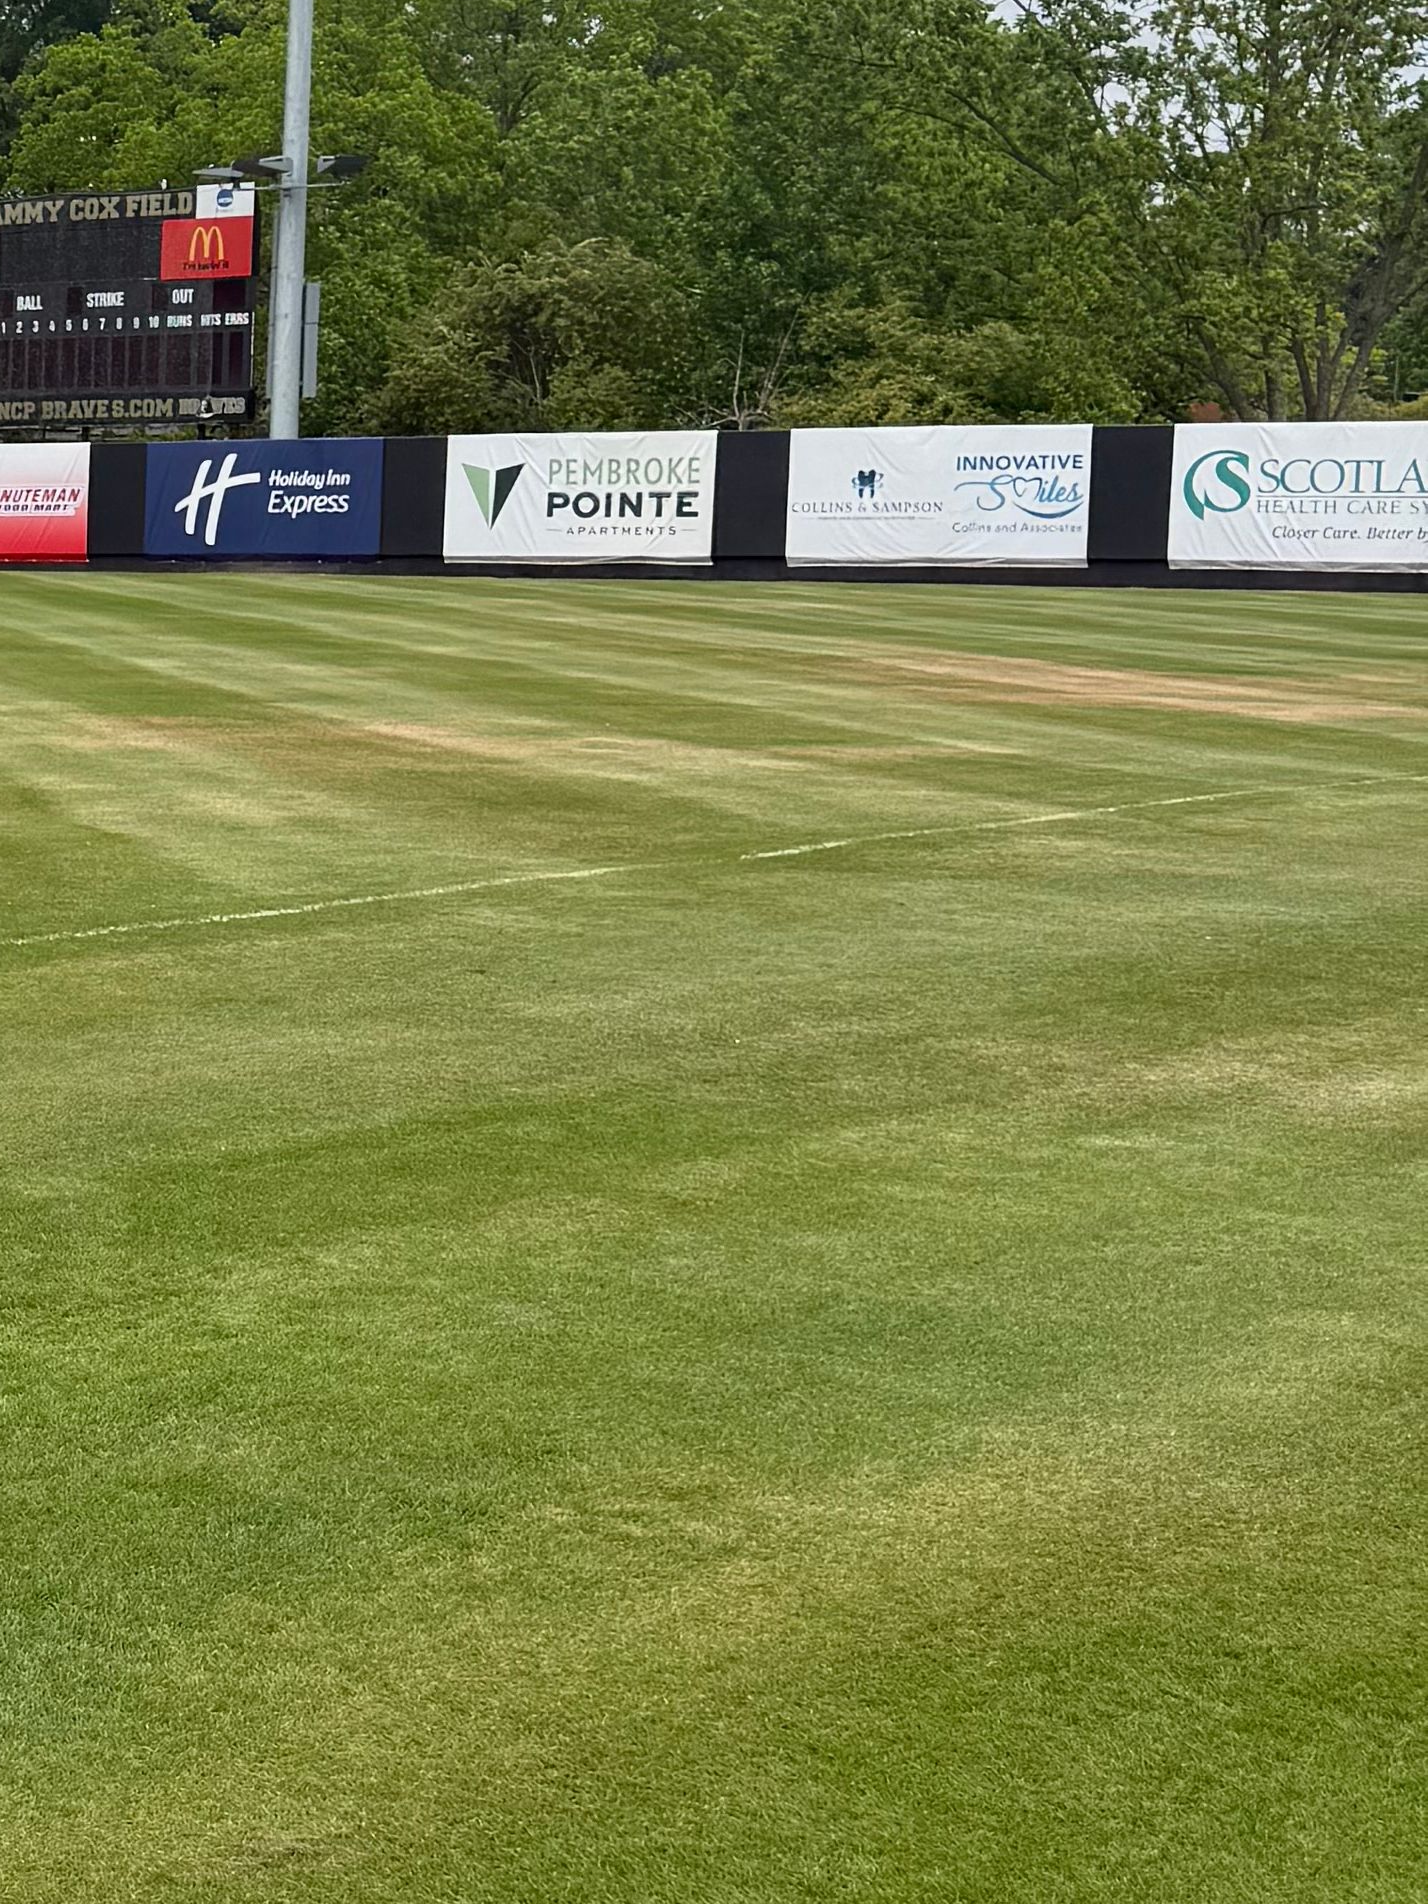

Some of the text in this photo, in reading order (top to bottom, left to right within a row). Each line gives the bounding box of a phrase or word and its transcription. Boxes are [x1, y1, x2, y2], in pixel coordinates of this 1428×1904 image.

[69, 196, 121, 221] COX
[124, 191, 194, 218] FIELD
[16, 295, 44, 311] BALL
[86, 291, 126, 308] STRIKE
[172, 289, 194, 304] OUT
[1, 321, 7, 334] 1
[15, 321, 23, 334] 2
[32, 320, 40, 333] 3
[48, 320, 56, 332] 4
[65, 319, 73, 332] 5
[82, 318, 89, 331] 6
[99, 318, 106, 330] 7
[116, 317, 123, 330] 8
[133, 317, 140, 329] 9
[149, 315, 160, 328] 10
[548, 457, 701, 485] PEMBROKE
[956, 454, 1084, 471] INNOVATIVE
[268, 469, 351, 490] Holiday Inn
[268, 490, 350, 519] Express
[546, 491, 700, 519] POINTE
[792, 501, 943, 513] COLLINS & SAMPSON
[1257, 499, 1337, 514] HEALTH
[1347, 499, 1401, 514] CARE
[566, 526, 677, 536] APARTMENTS
[994, 523, 1017, 533] and
[1020, 521, 1082, 532] Associates
[1272, 525, 1319, 539] Closer
[1323, 526, 1361, 539] Care.
[1367, 527, 1412, 539] Better
